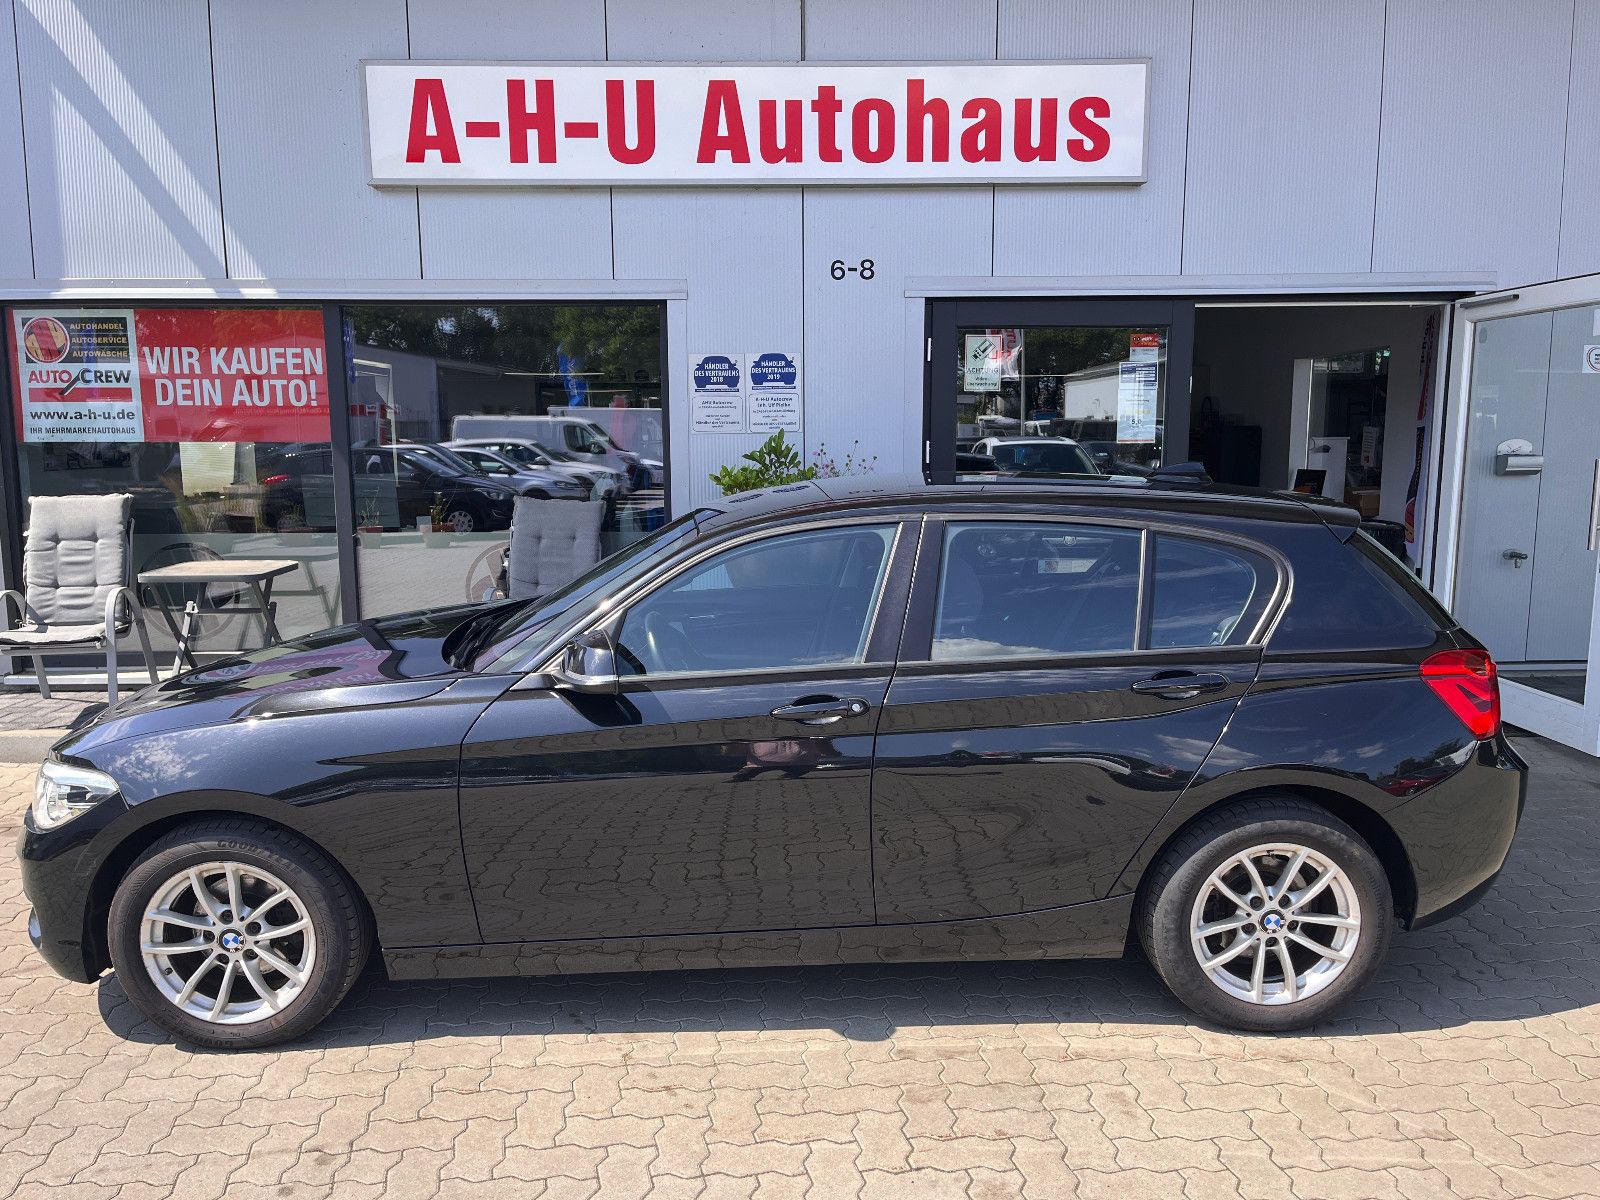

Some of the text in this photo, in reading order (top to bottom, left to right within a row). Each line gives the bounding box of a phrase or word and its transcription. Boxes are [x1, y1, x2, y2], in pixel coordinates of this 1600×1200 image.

[406, 78, 1111, 164] A-H-U Autohaus
[831, 259, 875, 280] 6-8
[143, 346, 323, 375] WIR KAUFEN
[704, 362, 729, 370] HÄNDLER
[28, 368, 131, 384] AUTO CREW
[155, 379, 318, 407] DEIN AUTO!
[30, 408, 136, 420] www.a-h-u.de
